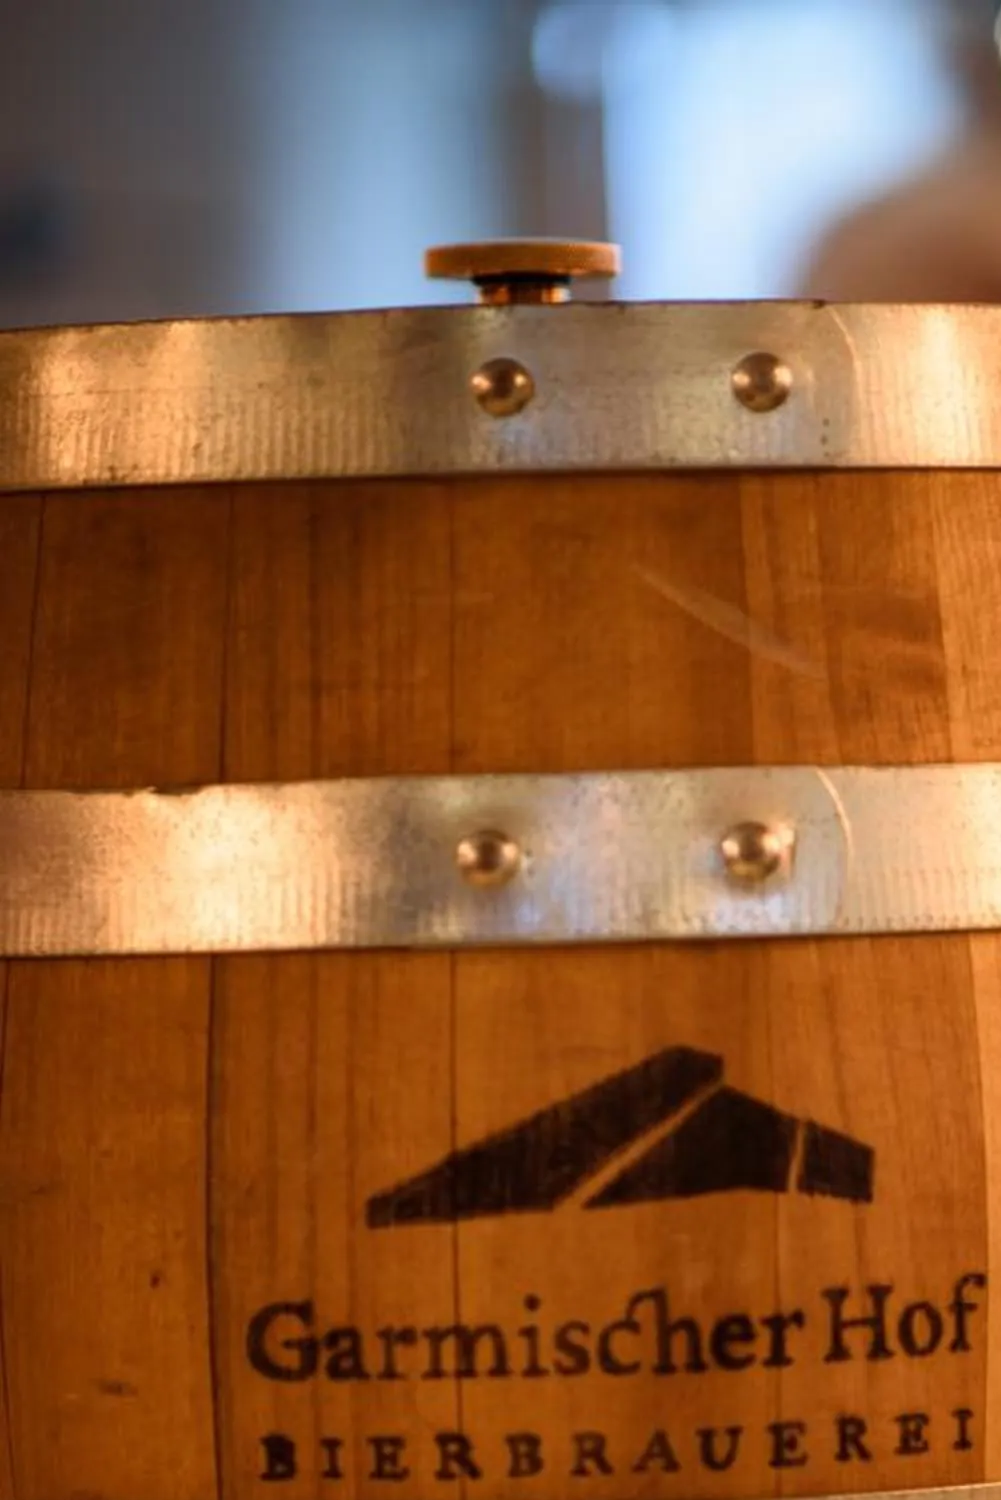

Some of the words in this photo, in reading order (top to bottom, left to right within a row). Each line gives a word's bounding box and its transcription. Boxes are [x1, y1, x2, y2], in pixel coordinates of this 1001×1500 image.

[246, 1288, 806, 1381] Garmischer
[822, 1273, 988, 1364] Hof
[259, 1409, 976, 1481] BIERBRAUEREI
